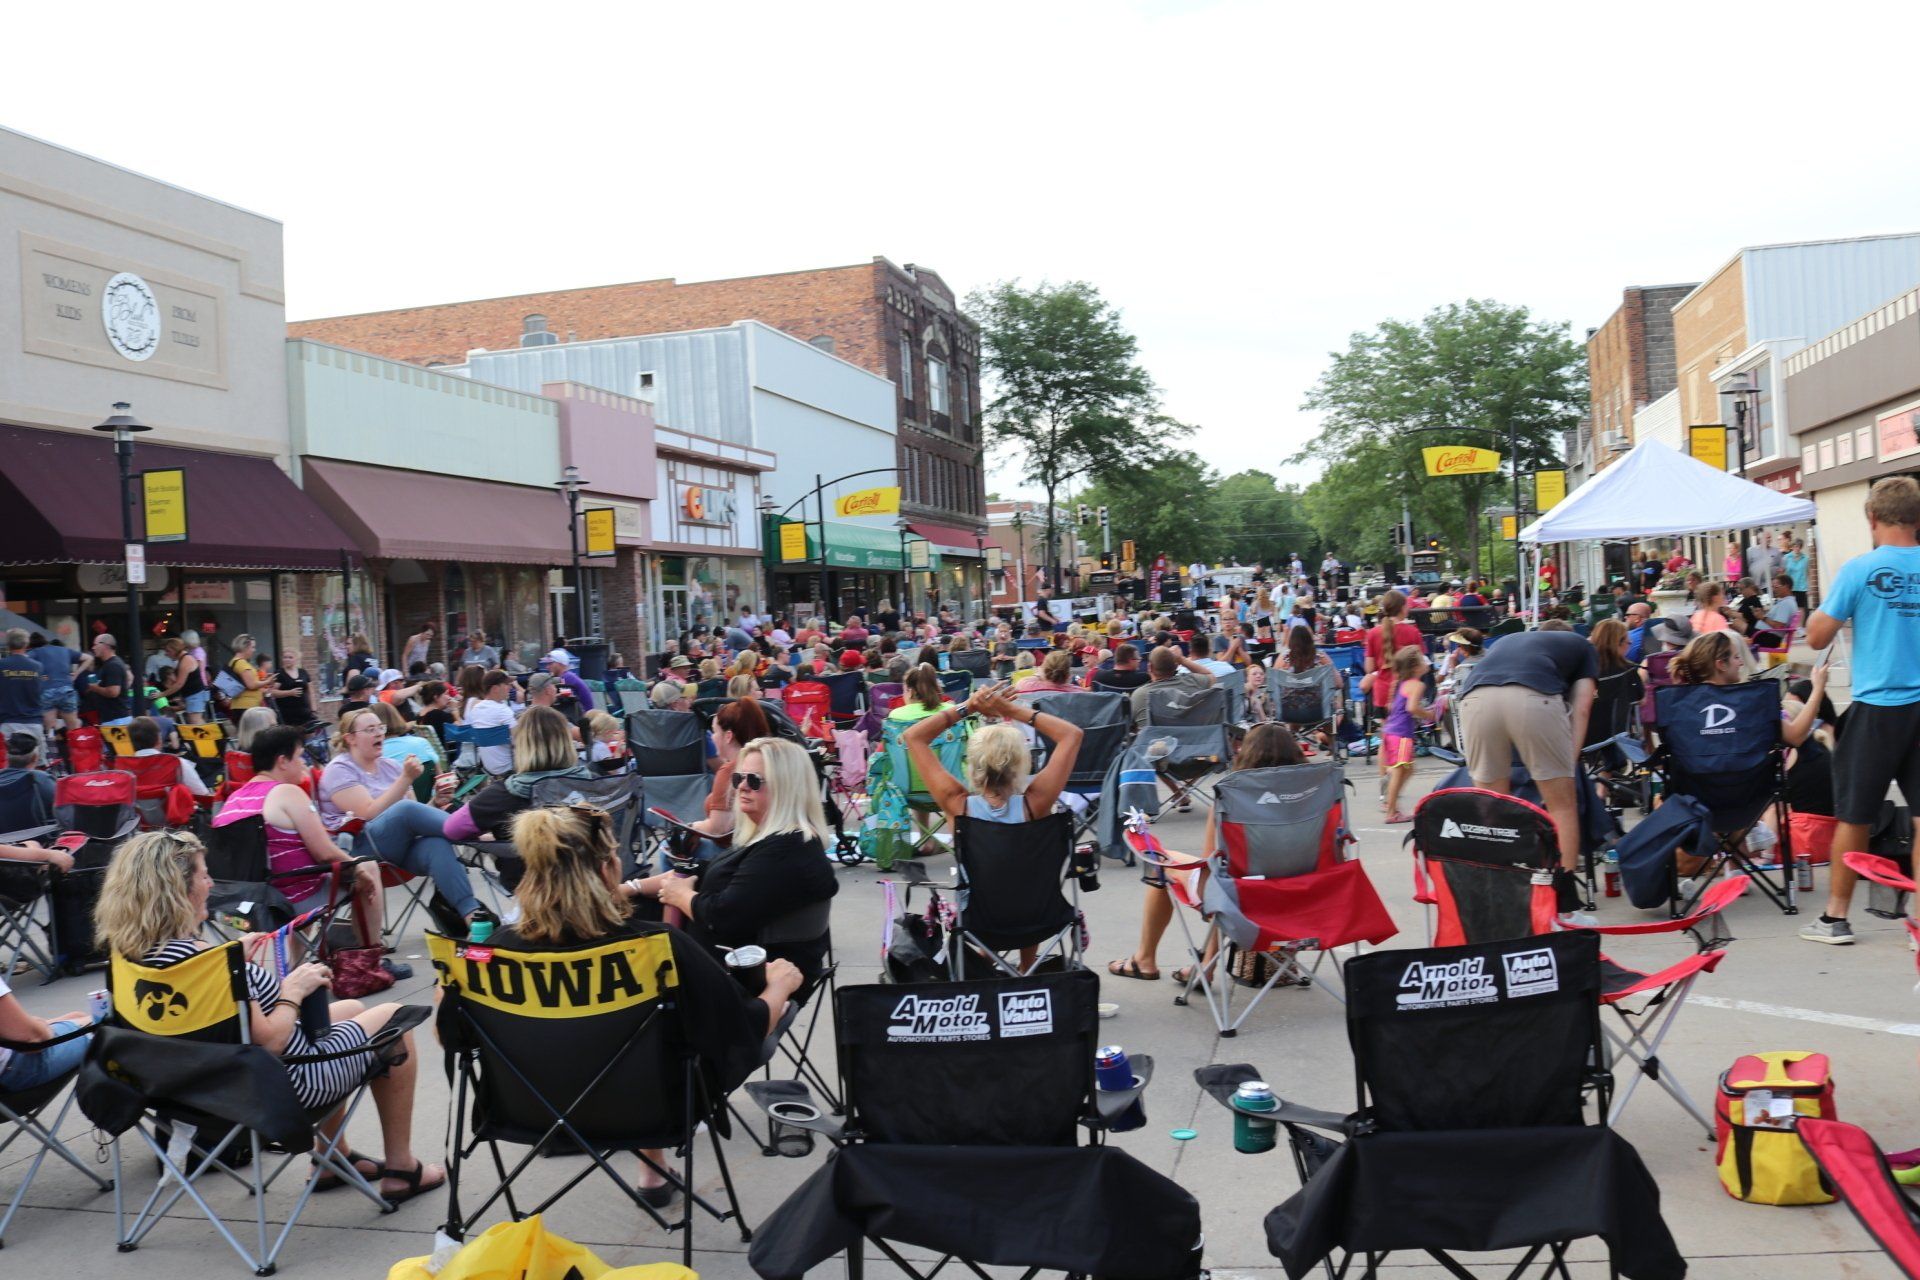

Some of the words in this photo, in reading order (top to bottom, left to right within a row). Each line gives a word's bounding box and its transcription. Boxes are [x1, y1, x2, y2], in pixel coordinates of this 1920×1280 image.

[1699, 704, 1736, 728] D
[1403, 957, 1483, 986] Arnold
[1511, 956, 1550, 971] Auto
[466, 951, 643, 1008] IOWA
[1510, 968, 1553, 984] Value
[1422, 976, 1493, 1000] Motor
[893, 995, 977, 1018] Arnold
[1004, 996, 1044, 1011] Auto
[1396, 1001, 1446, 1011] AUTOMOTIVE
[1447, 999, 1470, 1007] PARTS
[1471, 996, 1499, 1005] STORES
[913, 1013, 986, 1034] Motor
[1003, 1008, 1047, 1024] Value
[887, 1035, 937, 1043] AUTOMOTIVE
[938, 1034, 961, 1042] PARTS
[962, 1033, 991, 1041] STORES
